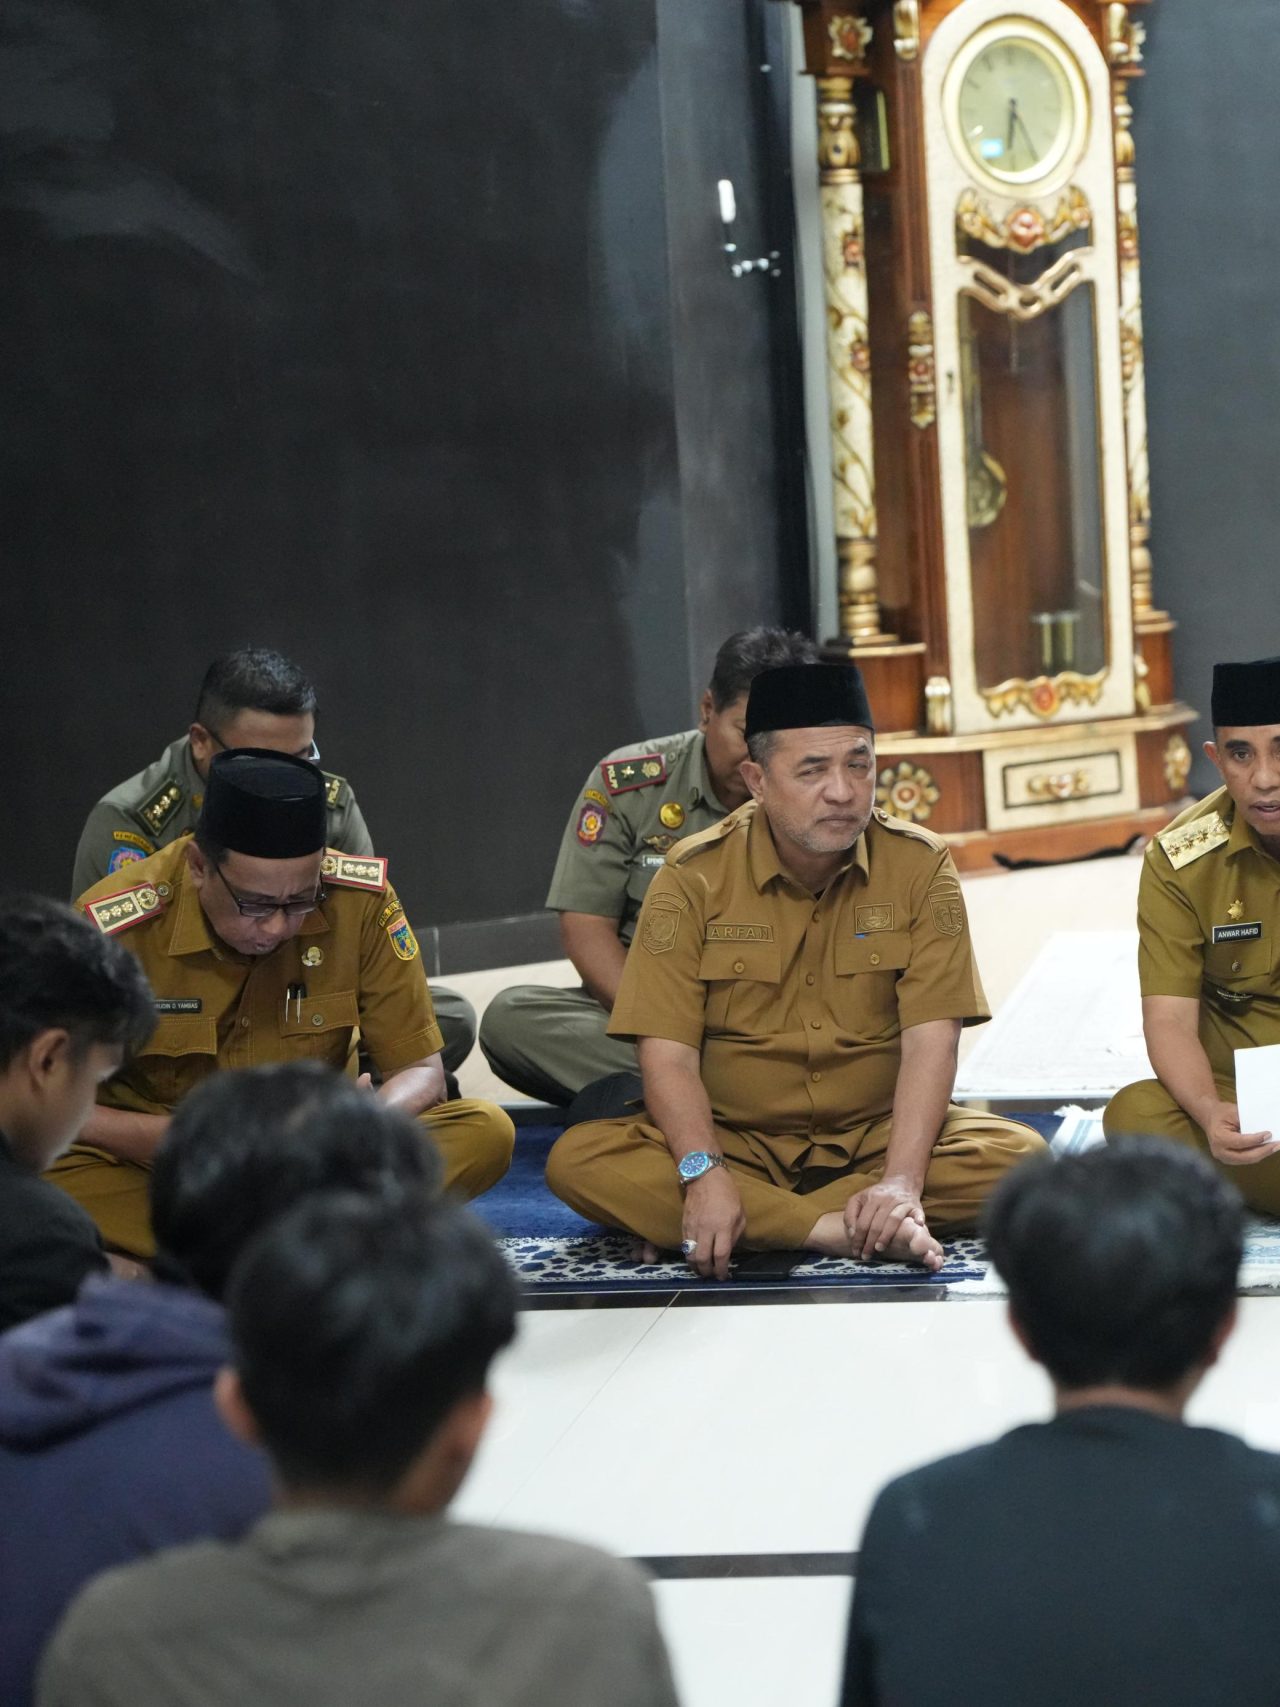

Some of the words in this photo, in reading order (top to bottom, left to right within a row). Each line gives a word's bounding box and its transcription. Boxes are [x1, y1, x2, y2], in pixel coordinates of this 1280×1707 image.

[711, 926, 769, 940] ARFAN
[1218, 930, 1240, 938] ANWAR
[1240, 927, 1259, 936] HAFID
